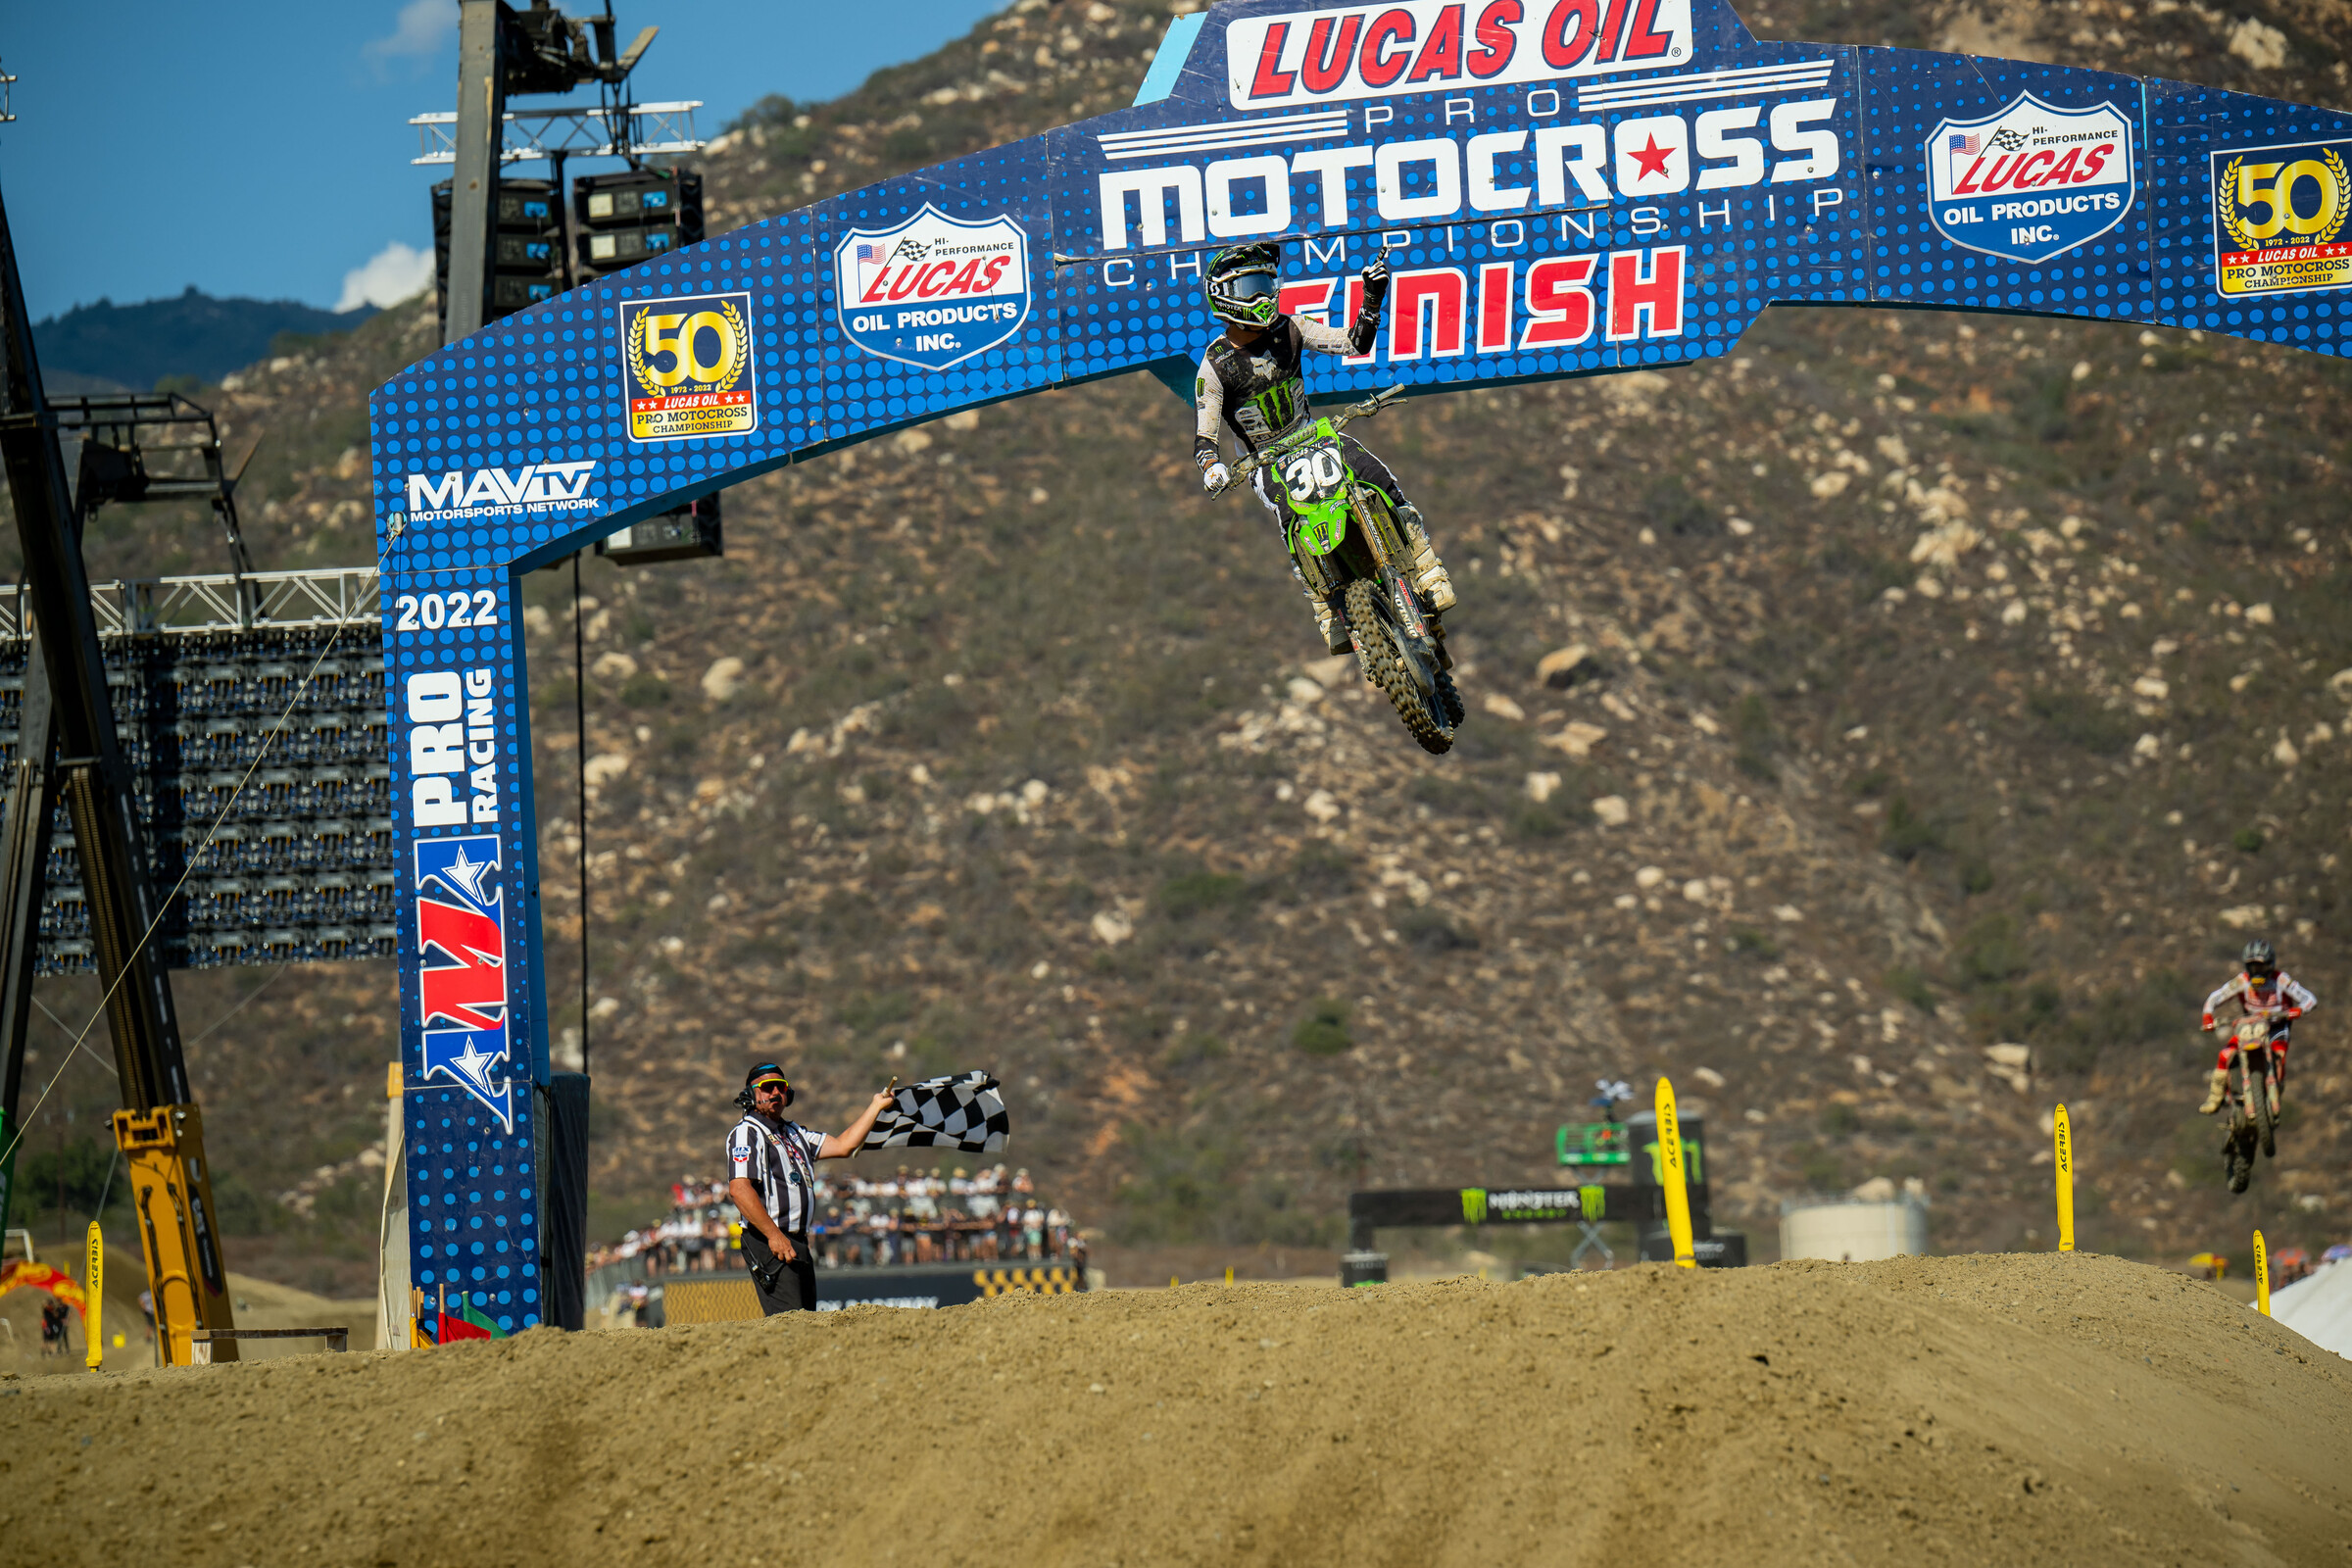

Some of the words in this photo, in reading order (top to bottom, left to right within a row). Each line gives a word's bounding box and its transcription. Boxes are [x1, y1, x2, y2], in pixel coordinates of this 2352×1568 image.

[1249, 0, 1524, 100] LUCAS
[1542, 0, 1674, 71] OIL
[1365, 88, 1559, 133] PRO
[2034, 130, 2118, 145] PERFORMANCE
[1099, 98, 1839, 250] MOTOCROSS
[1952, 143, 2115, 195] LUCAS
[1943, 207, 1984, 225] OIL
[1991, 192, 2121, 220] PRODUCTS
[2235, 160, 2339, 239] 50
[935, 242, 1014, 257] PERFORMANCE
[1102, 187, 1843, 287] CHMPIONSHIP
[2258, 249, 2296, 263] LUCAS
[2299, 247, 2318, 259] OIL
[860, 255, 1011, 303] LUCAS
[2227, 268, 2256, 279] PRO
[2261, 259, 2350, 276] MOTOCROSS
[2244, 273, 2333, 289] CHAMPIONSHIP
[853, 315, 890, 332] OIL
[898, 302, 1017, 328] PRODUCTS
[644, 311, 737, 387] 50
[637, 414, 663, 424] PRO
[667, 407, 748, 422] MOTOCROSS
[663, 396, 700, 409] LUCAS
[701, 394, 719, 406] OIL
[653, 420, 733, 433] CHAMPIONSHIP
[1285, 447, 1344, 502] 30
[1287, 446, 1309, 465] LUCAS
[409, 461, 596, 512] MAVTV
[411, 504, 522, 522] MOTORSPORTS
[526, 498, 599, 513] NETWORK
[395, 590, 498, 631] 2022
[407, 671, 467, 827] PRO
[466, 668, 499, 823] RACING
[1664, 1103, 1677, 1168] ACERBIS
[2059, 1122, 2068, 1172] ACERBIS
